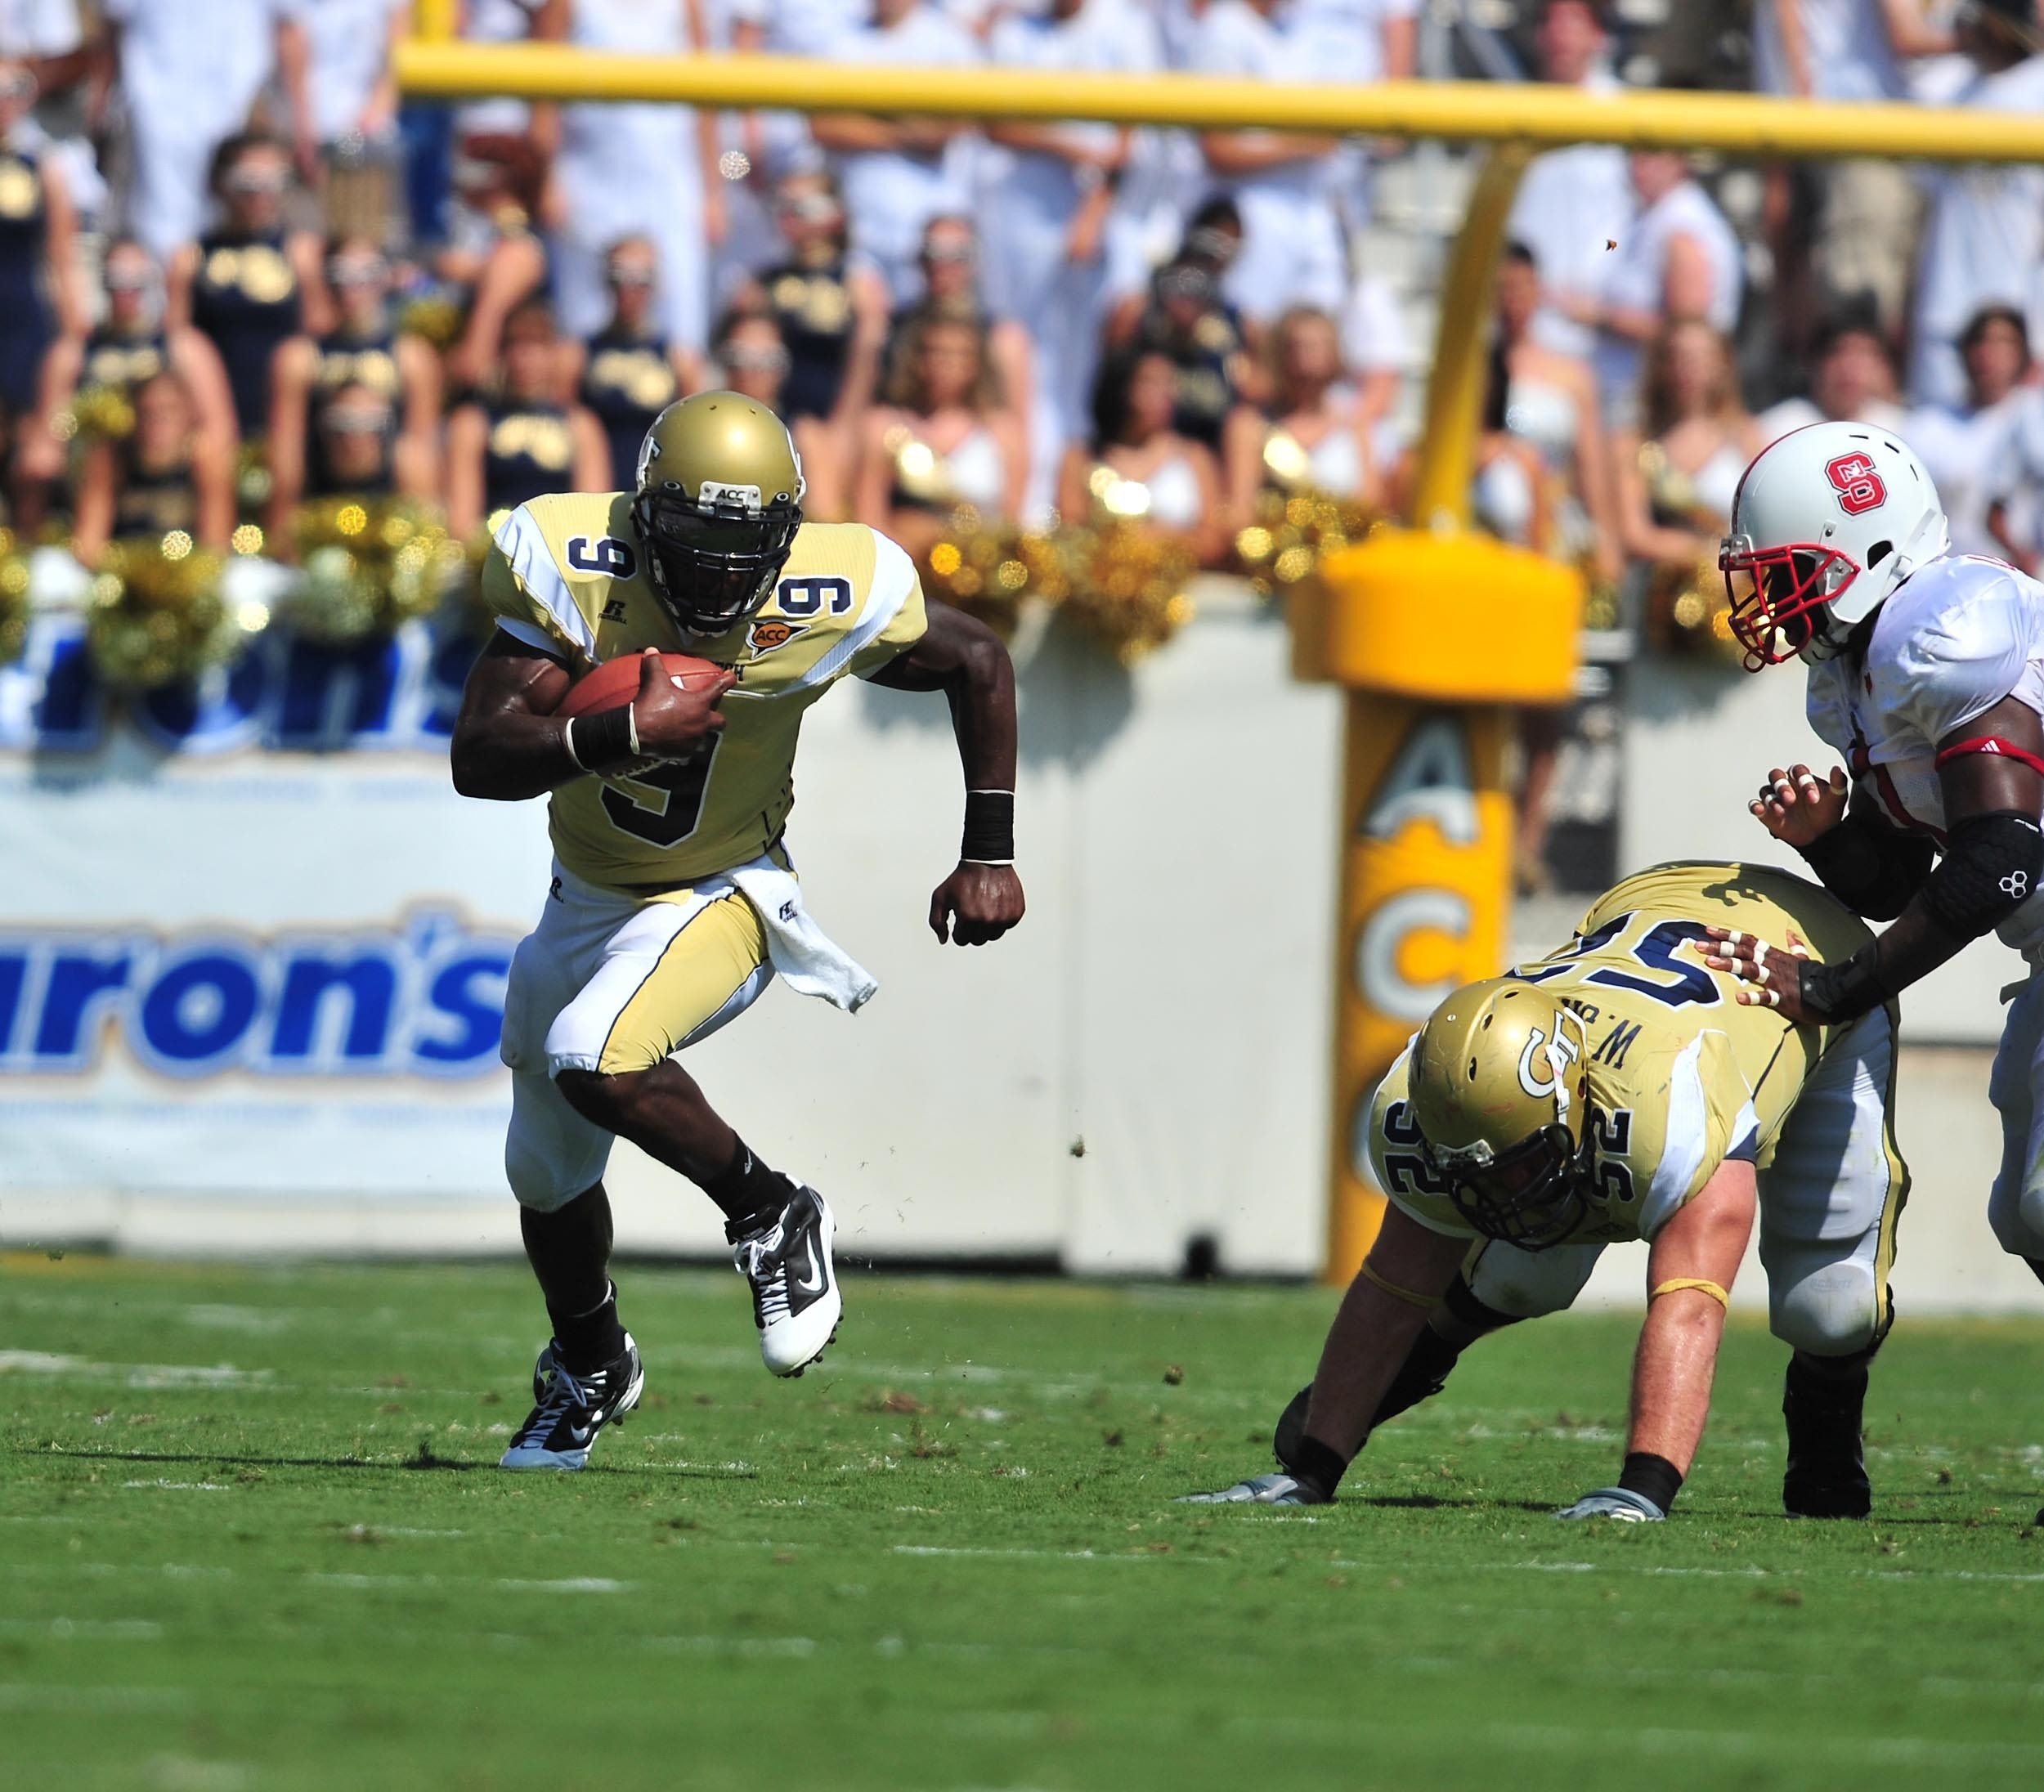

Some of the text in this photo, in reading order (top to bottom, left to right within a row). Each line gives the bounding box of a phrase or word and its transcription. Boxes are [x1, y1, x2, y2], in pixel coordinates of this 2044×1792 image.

[716, 489, 746, 501] ACC
[565, 535, 638, 580] 9
[777, 575, 854, 617] 9
[756, 629, 786, 642] ACC
[0, 914, 513, 1065] ron's
